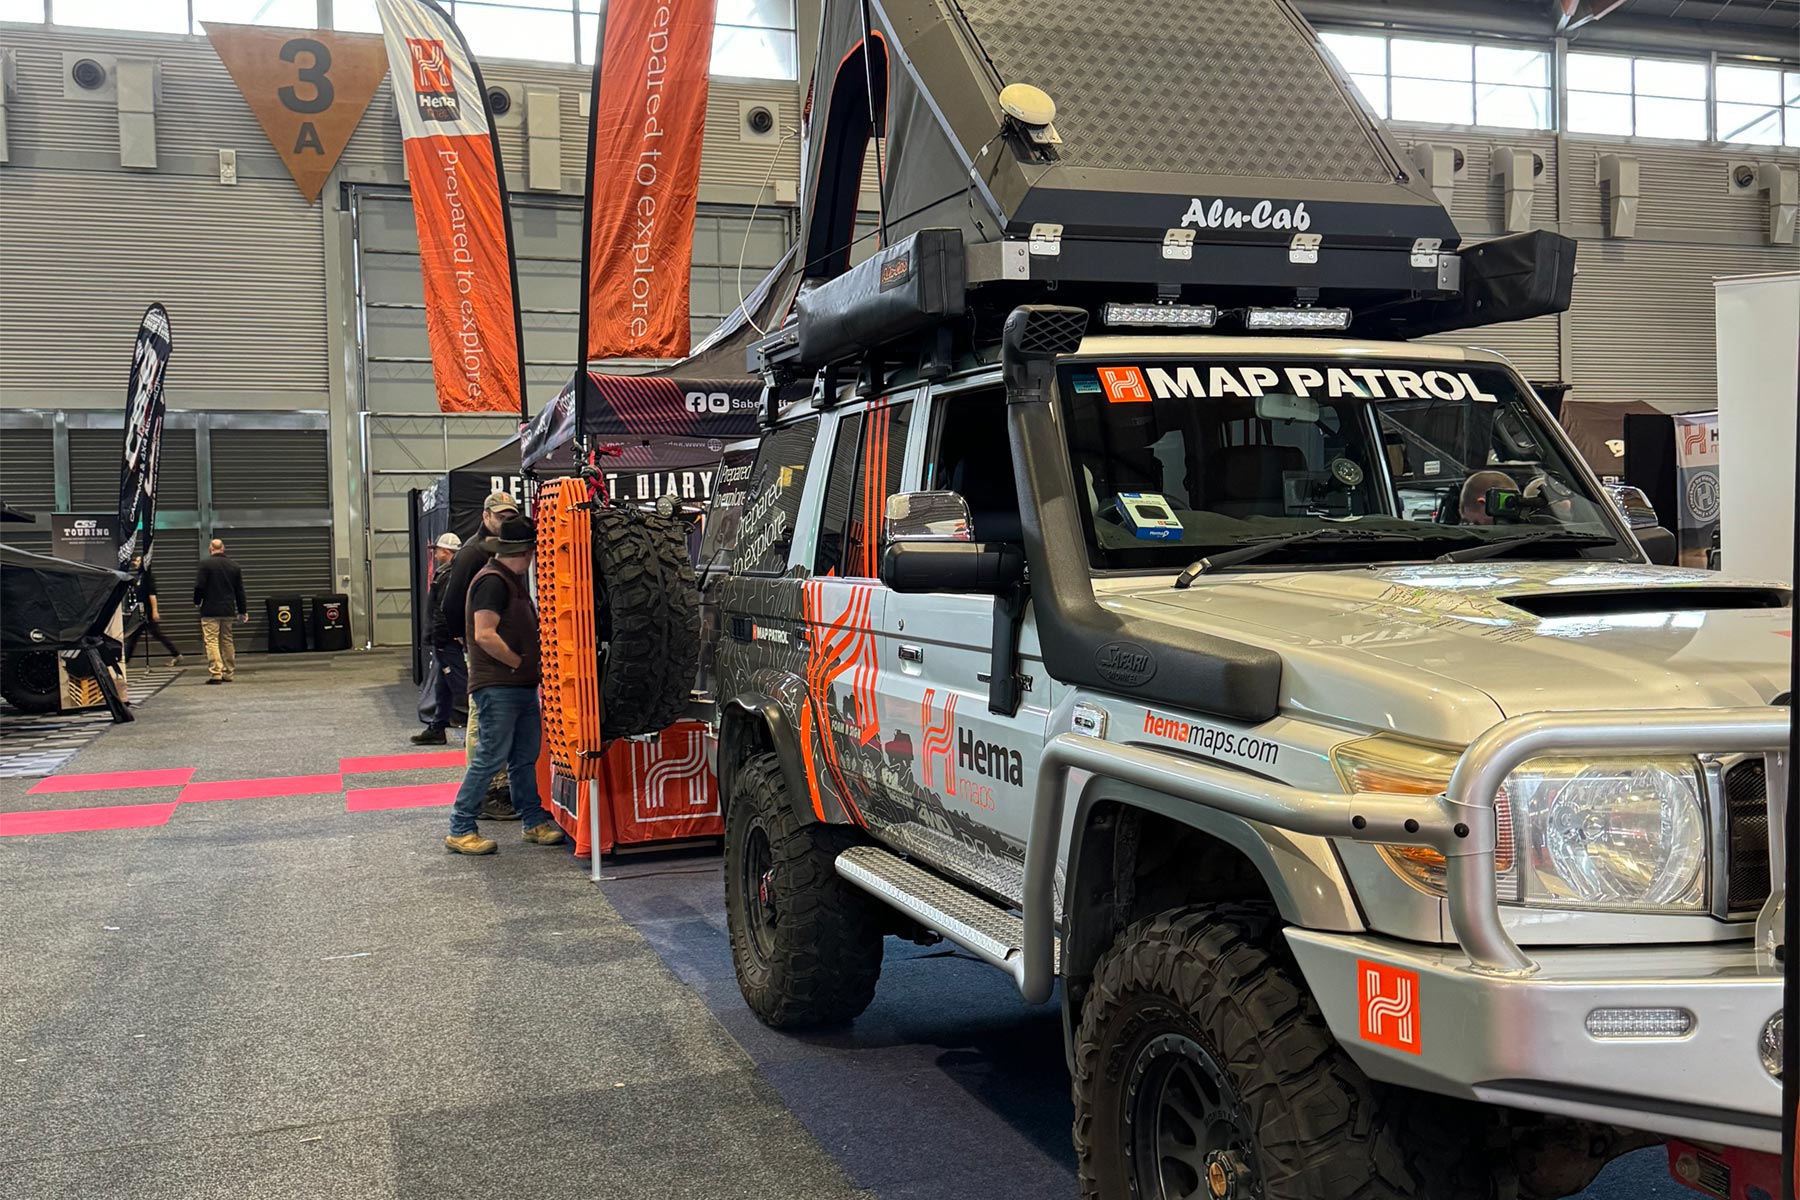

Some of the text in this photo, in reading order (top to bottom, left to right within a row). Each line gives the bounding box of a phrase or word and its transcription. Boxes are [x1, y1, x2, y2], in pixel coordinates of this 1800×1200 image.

[278, 38, 334, 114] 3
[644, 0, 672, 141] epared
[294, 122, 325, 155] A
[636, 149, 662, 187] to
[1181, 198, 1311, 231] Alu-Cab
[456, 269, 475, 294] to
[1145, 367, 1279, 399] MAP
[1284, 367, 1498, 403] PATROL
[64, 528, 110, 536] TOURING
[744, 511, 787, 570] explore
[1144, 710, 1279, 764] hemamaps.com
[958, 727, 1023, 787] Hema
[959, 778, 996, 811] maps
